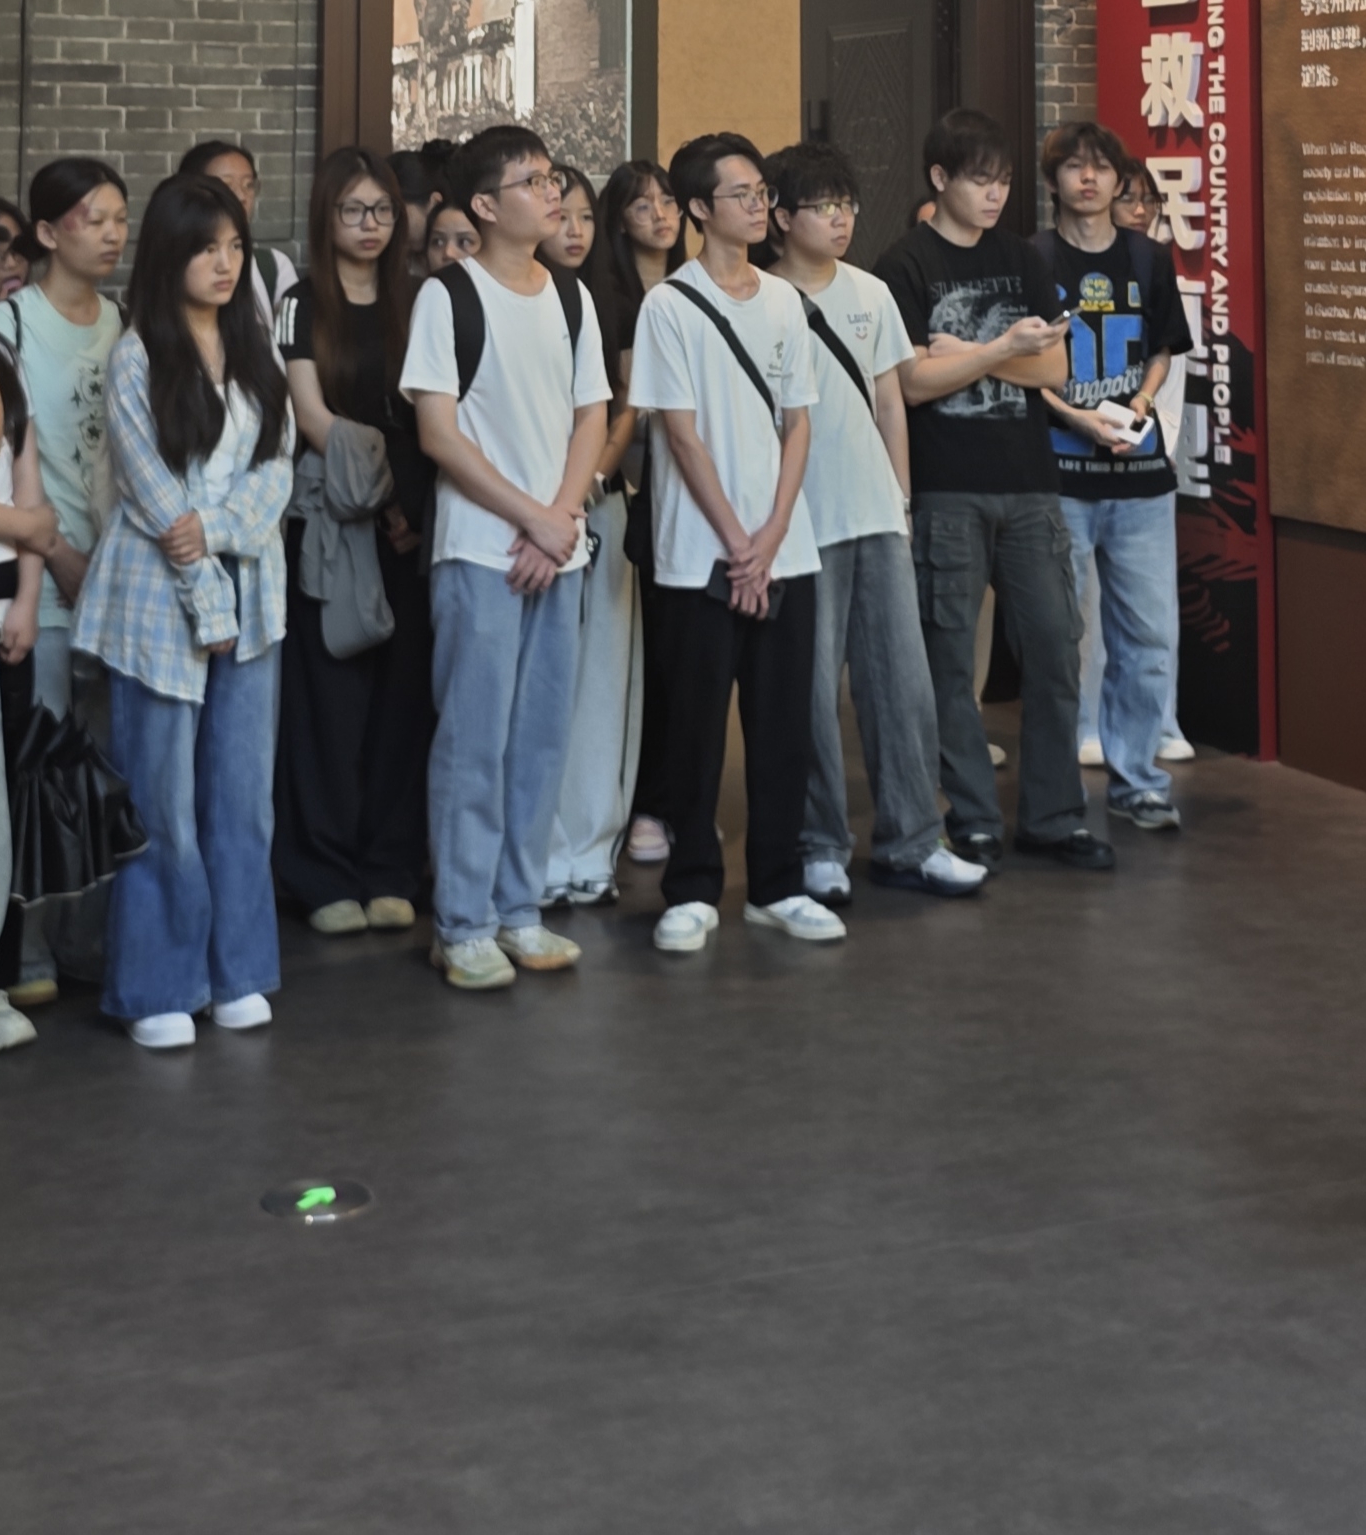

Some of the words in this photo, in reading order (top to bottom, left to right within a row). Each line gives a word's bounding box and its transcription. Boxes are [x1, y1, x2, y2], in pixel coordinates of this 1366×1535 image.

[1208, 54, 1227, 115] THE
[1208, 122, 1229, 267] COUNTRY
[1210, 270, 1230, 337] AND
[1212, 343, 1232, 465] PEOPLE
